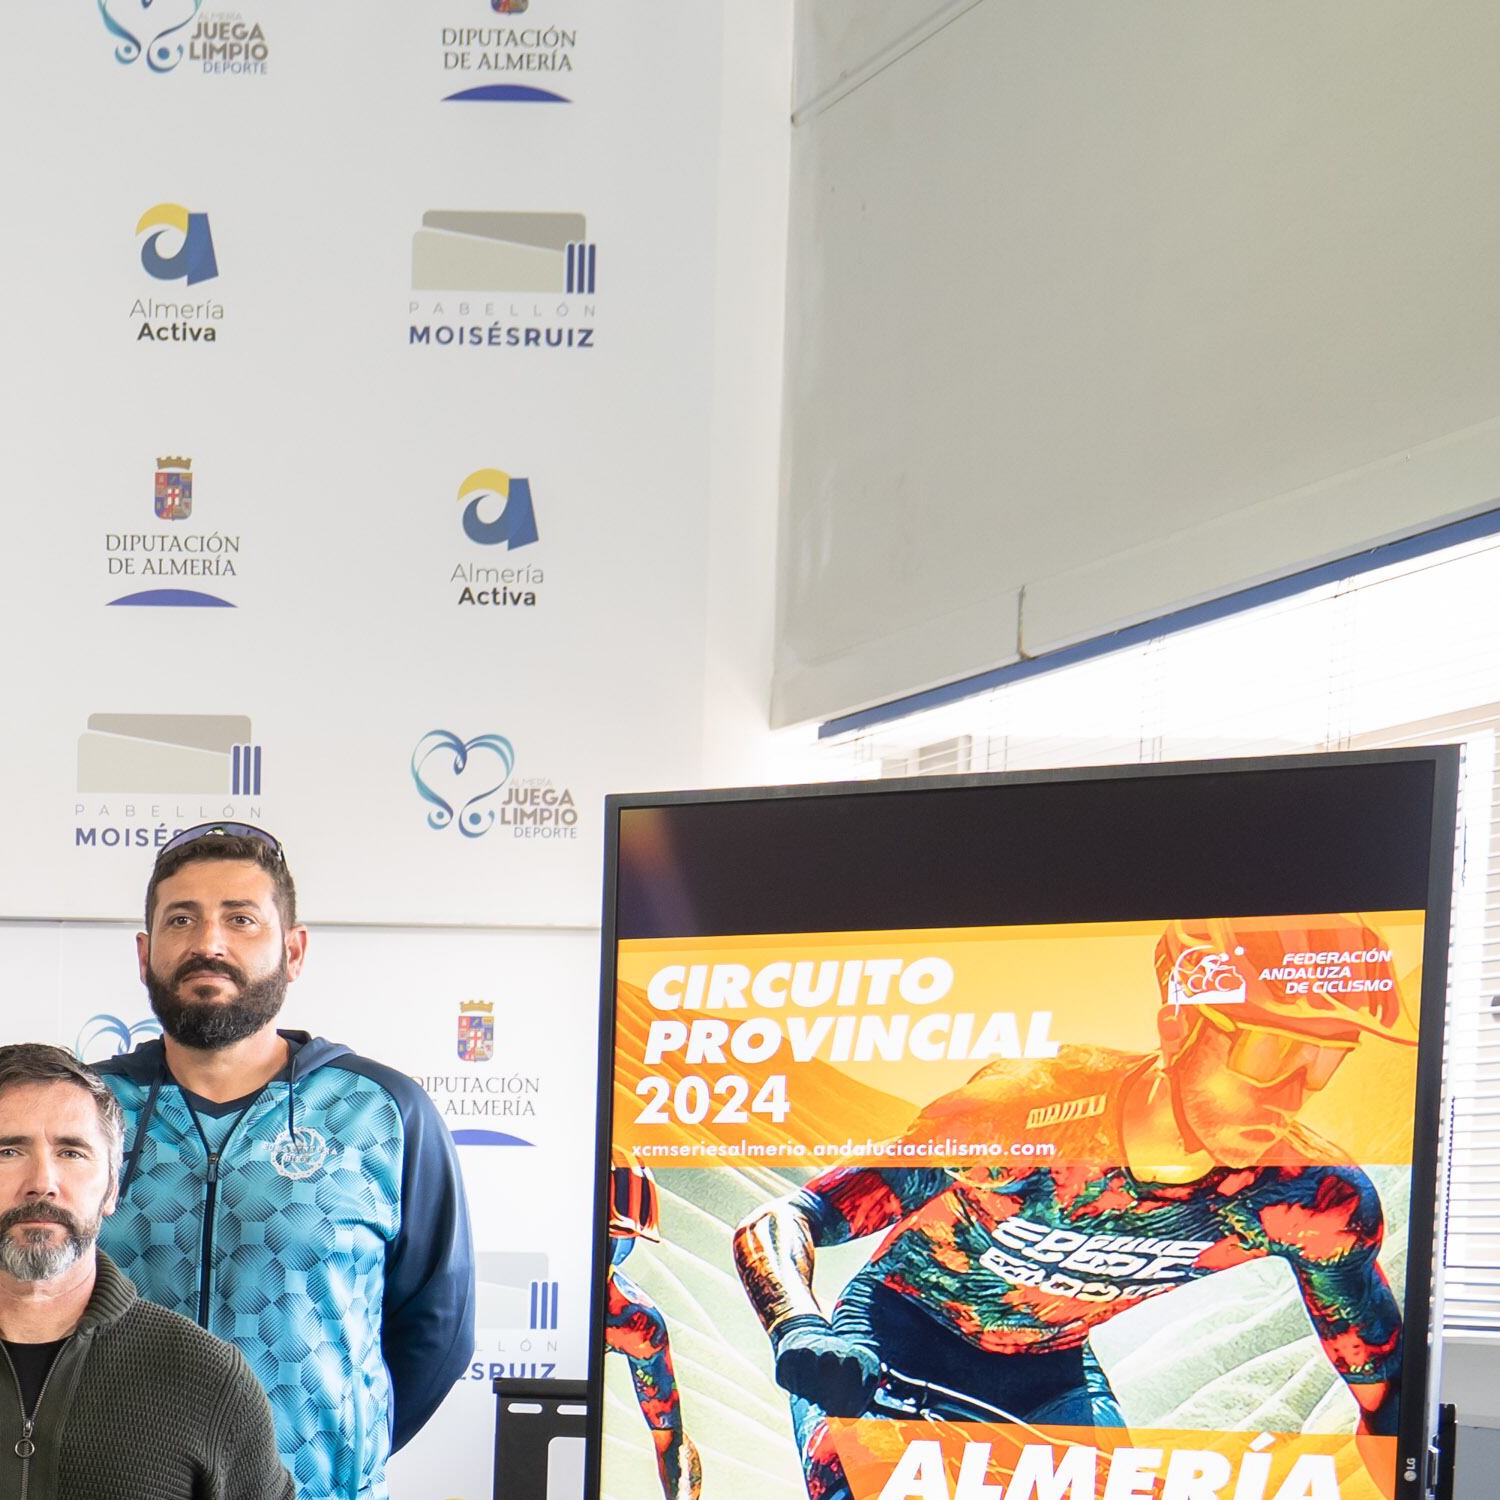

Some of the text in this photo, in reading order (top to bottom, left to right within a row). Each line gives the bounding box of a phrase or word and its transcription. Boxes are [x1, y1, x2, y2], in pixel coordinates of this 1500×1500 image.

[187, 21, 265, 41] JUEGA
[442, 26, 576, 48] DIPUTACIÓN
[189, 41, 268, 61] LIMPIO
[444, 50, 572, 71] DE ALMERÍA
[203, 60, 267, 74] DEPORTE
[129, 299, 224, 322] Almería
[409, 302, 595, 317] PABELLÓN
[137, 322, 216, 342] Activa
[410, 321, 593, 347] MOISÉSRUIZ
[106, 532, 240, 553] DIPUTACIÓN
[108, 555, 236, 576] DE ALMERÍA
[451, 563, 544, 584] Almería
[458, 586, 536, 606] Activa
[501, 788, 574, 809] JUEGA
[75, 804, 261, 818] PABELLÓN
[501, 807, 578, 829] LIMPIO
[75, 823, 182, 847] MOISÉ
[514, 826, 576, 839] DEPORTE
[1282, 948, 1393, 965] FEDERACIÓN
[647, 957, 954, 1010] CIRCUITO
[1259, 967, 1351, 980] ANDALUZA
[1286, 979, 1393, 994] DE CICLISMO
[643, 1011, 1061, 1065] PROVINCIAL
[444, 1097, 536, 1115] ALMERÍA
[633, 1074, 790, 1125] 2024
[1406, 1458, 1416, 1470] LG
